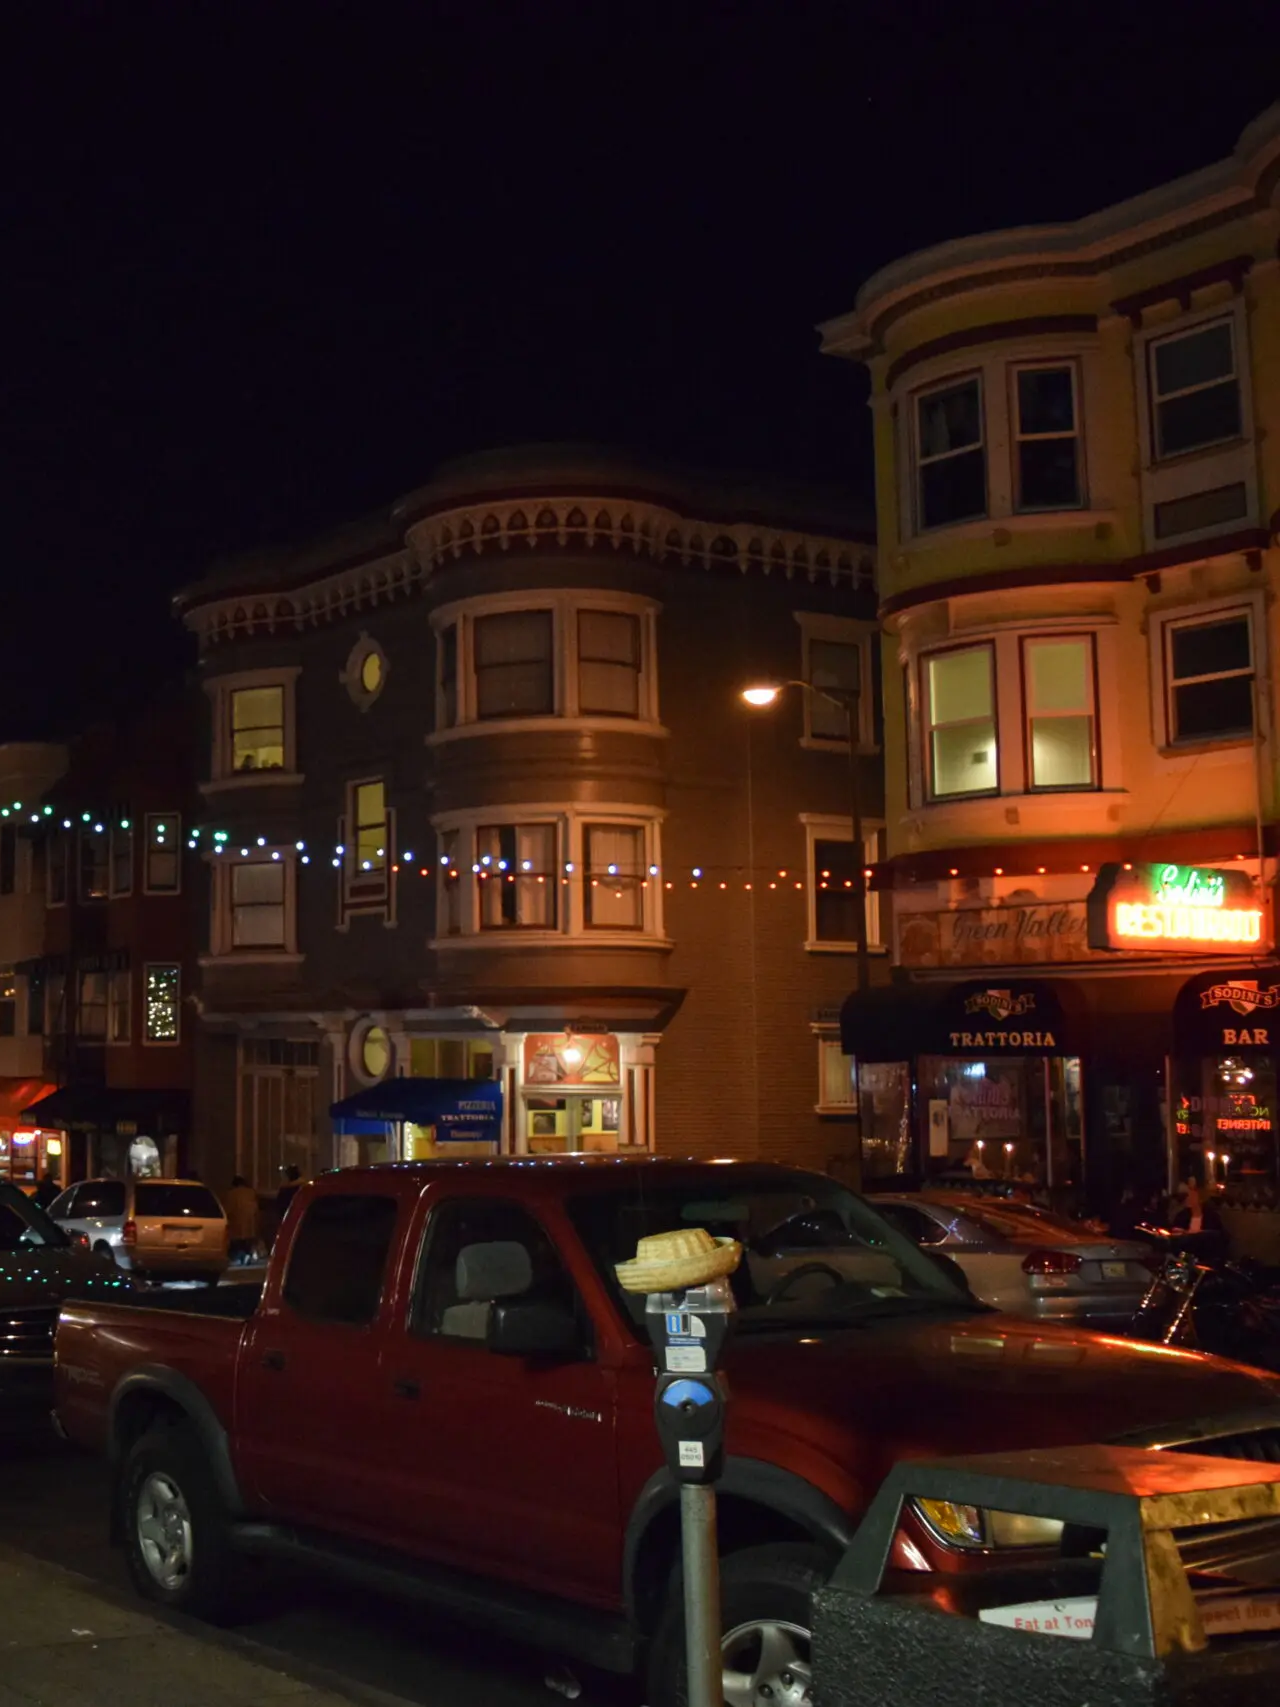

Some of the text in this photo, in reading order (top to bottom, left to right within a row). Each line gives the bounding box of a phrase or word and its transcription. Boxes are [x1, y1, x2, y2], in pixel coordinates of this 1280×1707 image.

[952, 914, 1008, 946] Green
[1214, 986, 1273, 1006] SODINI'S
[949, 1031, 1057, 1047] TRATTORIA
[1223, 1028, 1270, 1045] BAR
[1014, 1615, 1096, 1632] Eat at Ton
